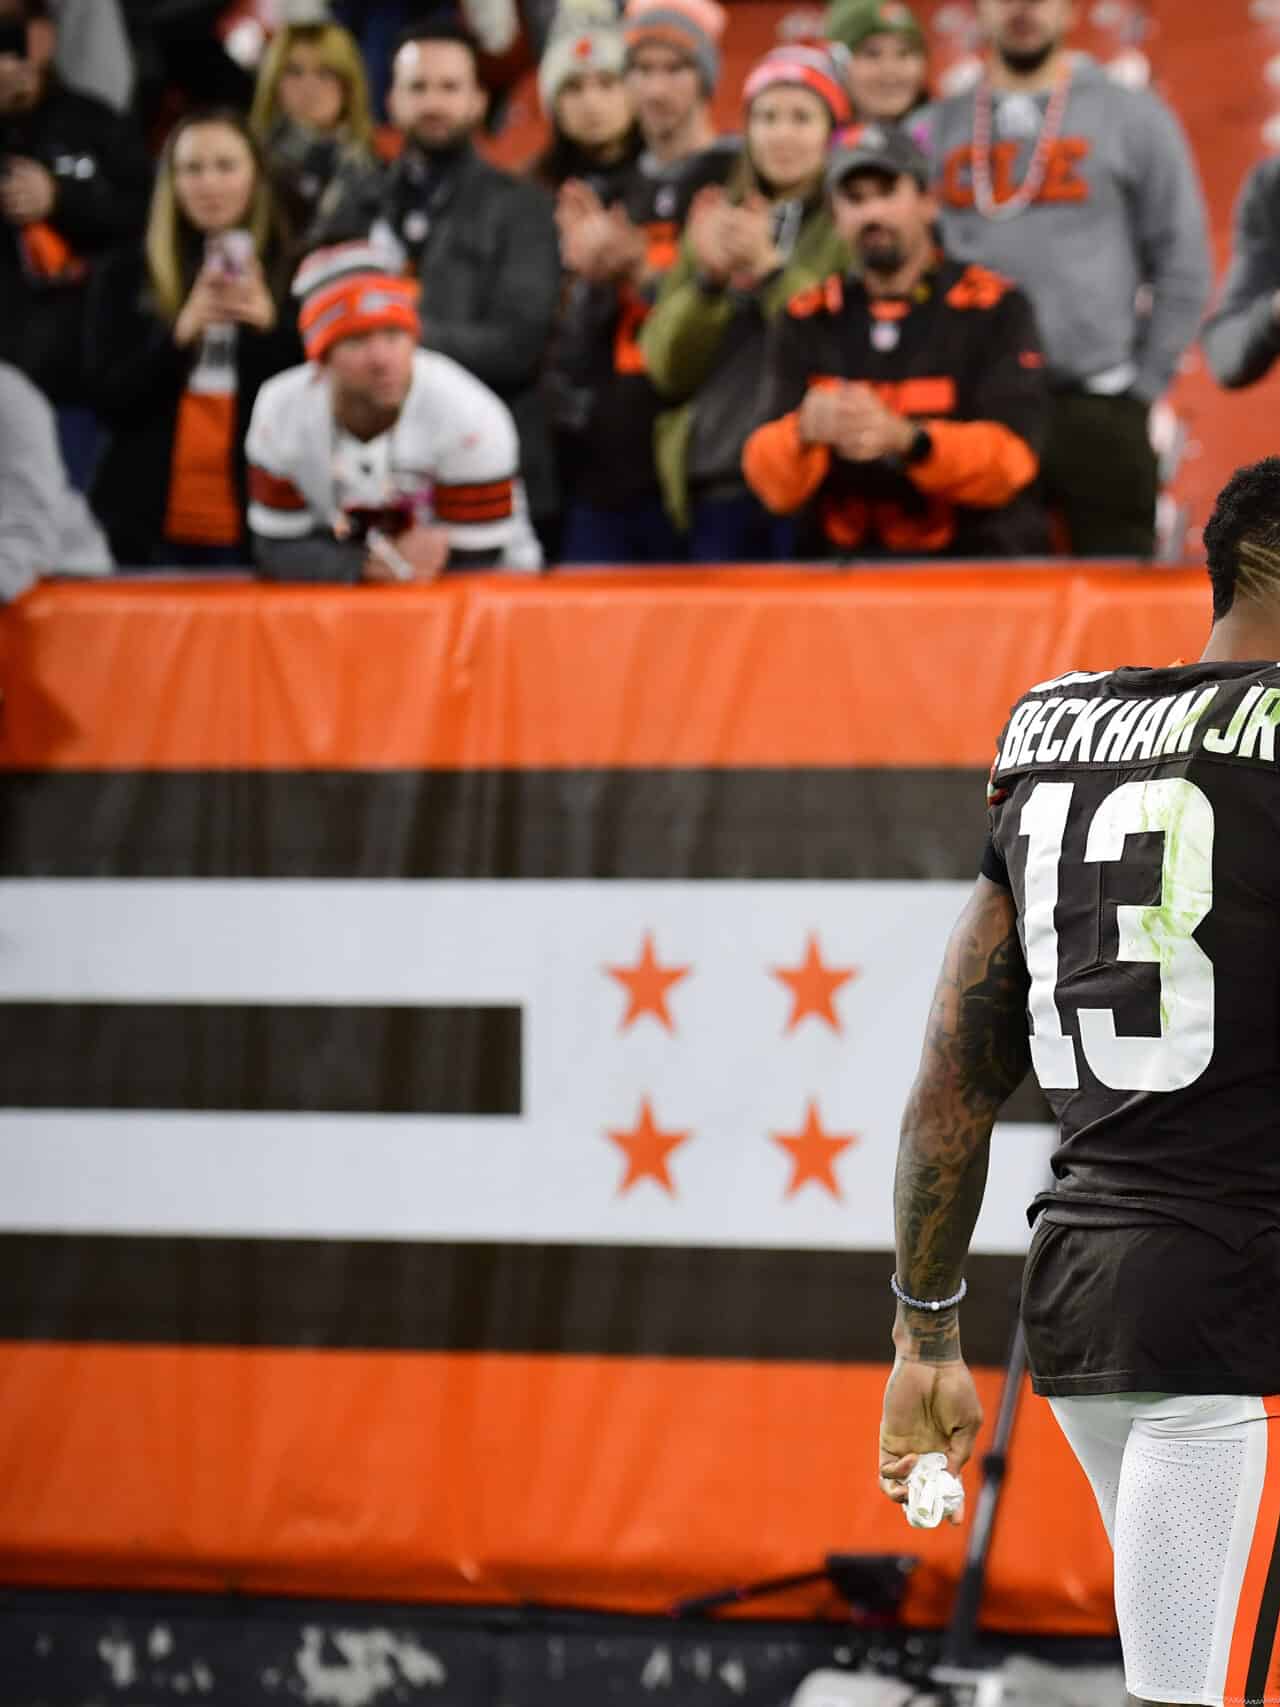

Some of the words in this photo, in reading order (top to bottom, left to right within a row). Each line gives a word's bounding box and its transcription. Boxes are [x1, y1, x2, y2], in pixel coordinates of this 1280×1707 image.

[943, 136, 1090, 208] CLE
[998, 685, 1218, 771] BECKHAM
[1019, 777, 1215, 1092] 13
